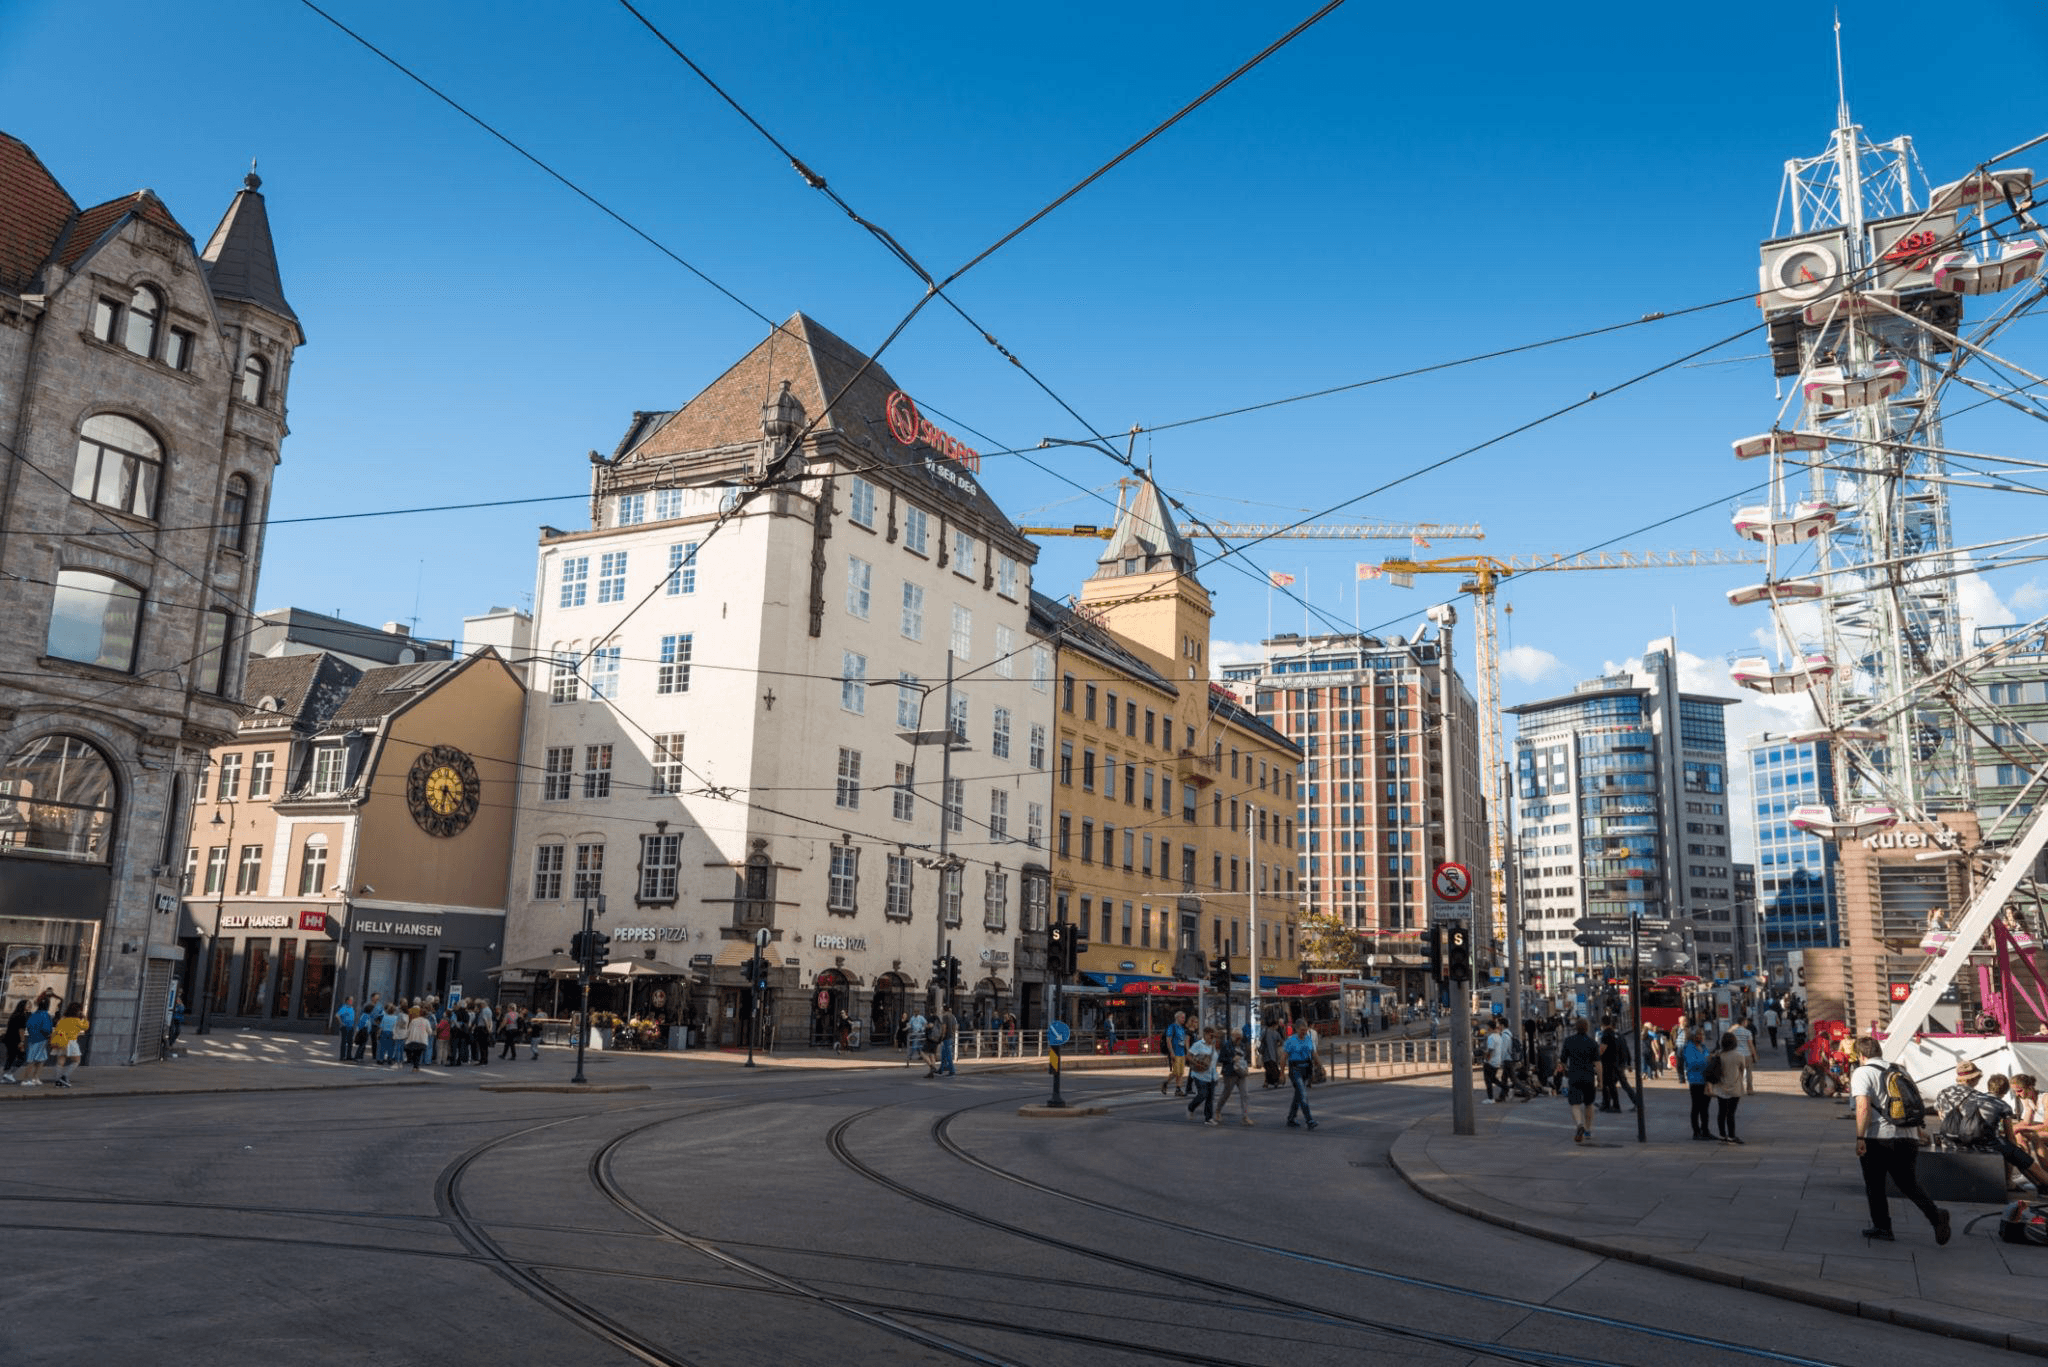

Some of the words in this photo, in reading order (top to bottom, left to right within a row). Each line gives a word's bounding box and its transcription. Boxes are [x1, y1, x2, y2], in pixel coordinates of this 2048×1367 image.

[1896, 231, 1936, 252] NSB
[938, 465, 956, 485] SER
[958, 477, 977, 496] DEG
[220, 916, 248, 927] HELLY
[249, 916, 290, 927] HANSEN
[304, 915, 324, 927] HH
[355, 920, 393, 934] HELLY
[394, 923, 442, 936] HANSEN
[614, 927, 656, 941] PEPPES
[658, 927, 687, 941] PIZZA
[815, 935, 847, 950] PEPPES
